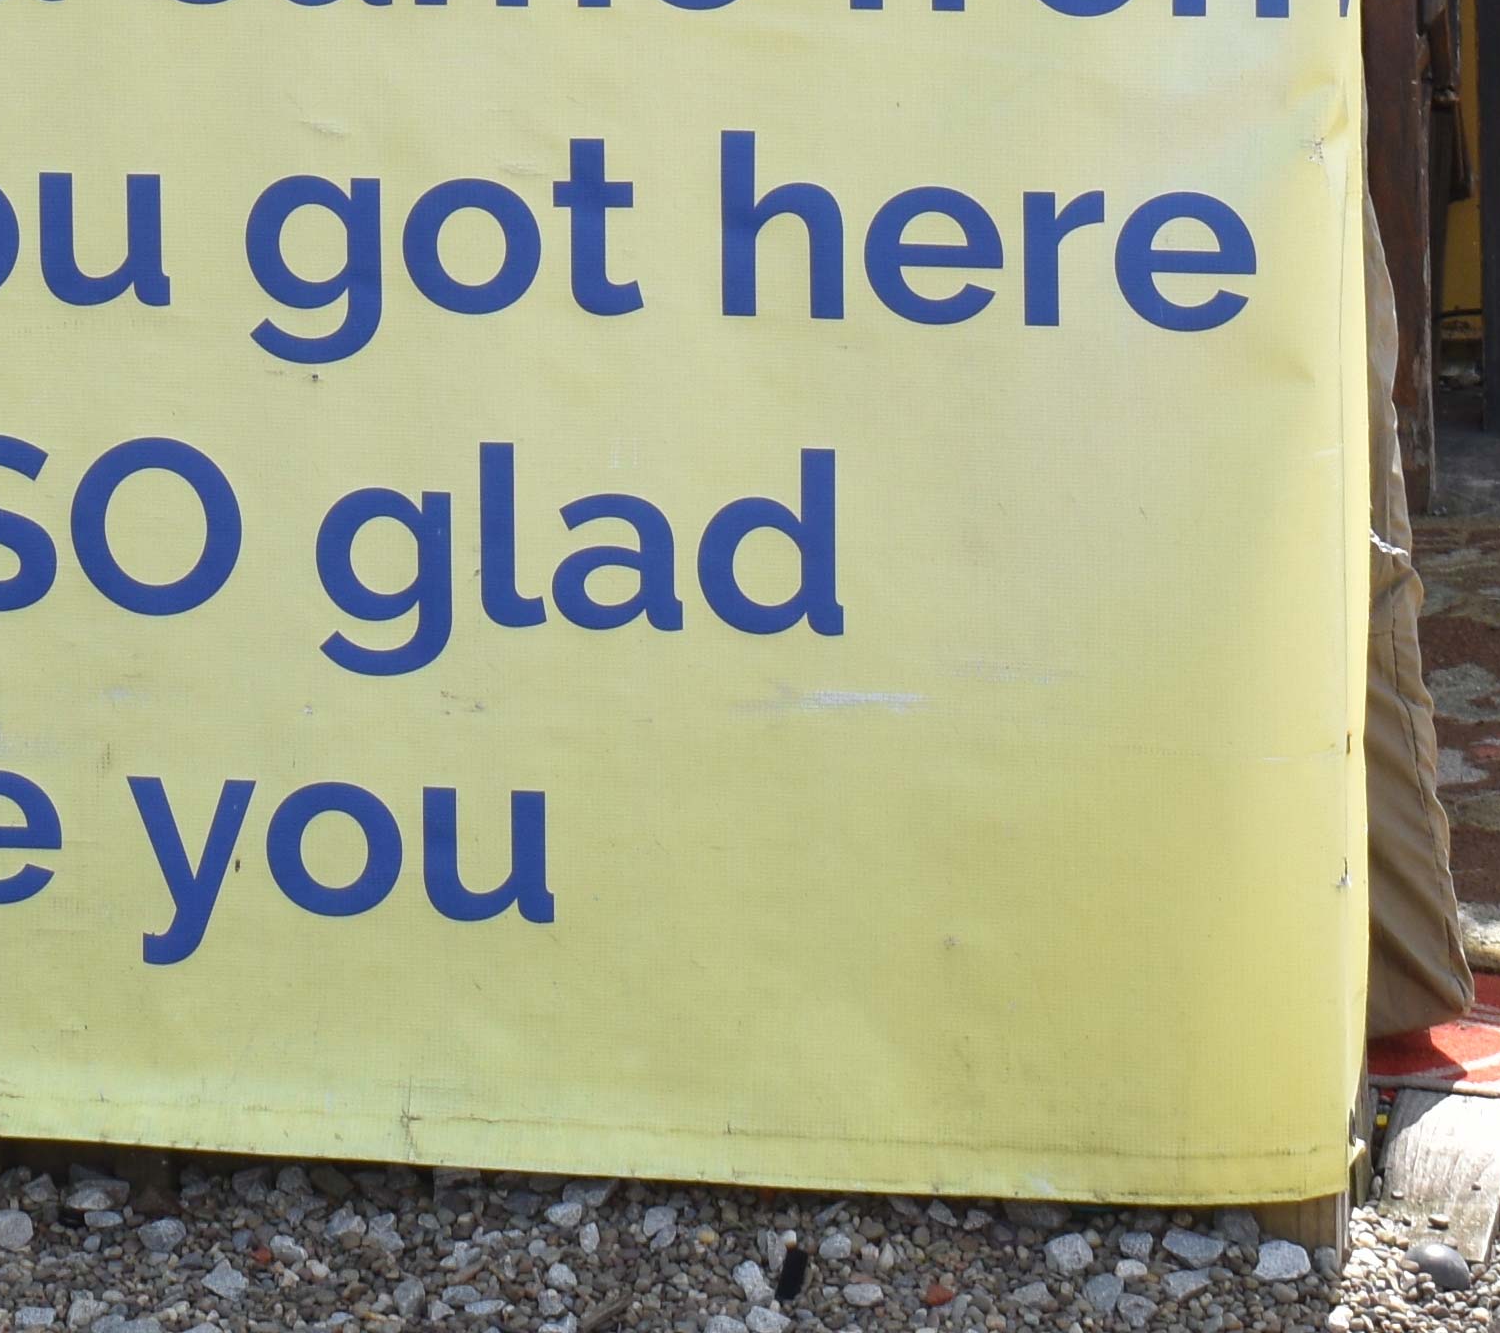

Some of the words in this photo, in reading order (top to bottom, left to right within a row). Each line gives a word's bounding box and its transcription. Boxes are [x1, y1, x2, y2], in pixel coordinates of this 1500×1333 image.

[243, 137, 641, 367] got
[713, 128, 1258, 333] here
[313, 441, 846, 679] glad
[126, 778, 556, 967] you
